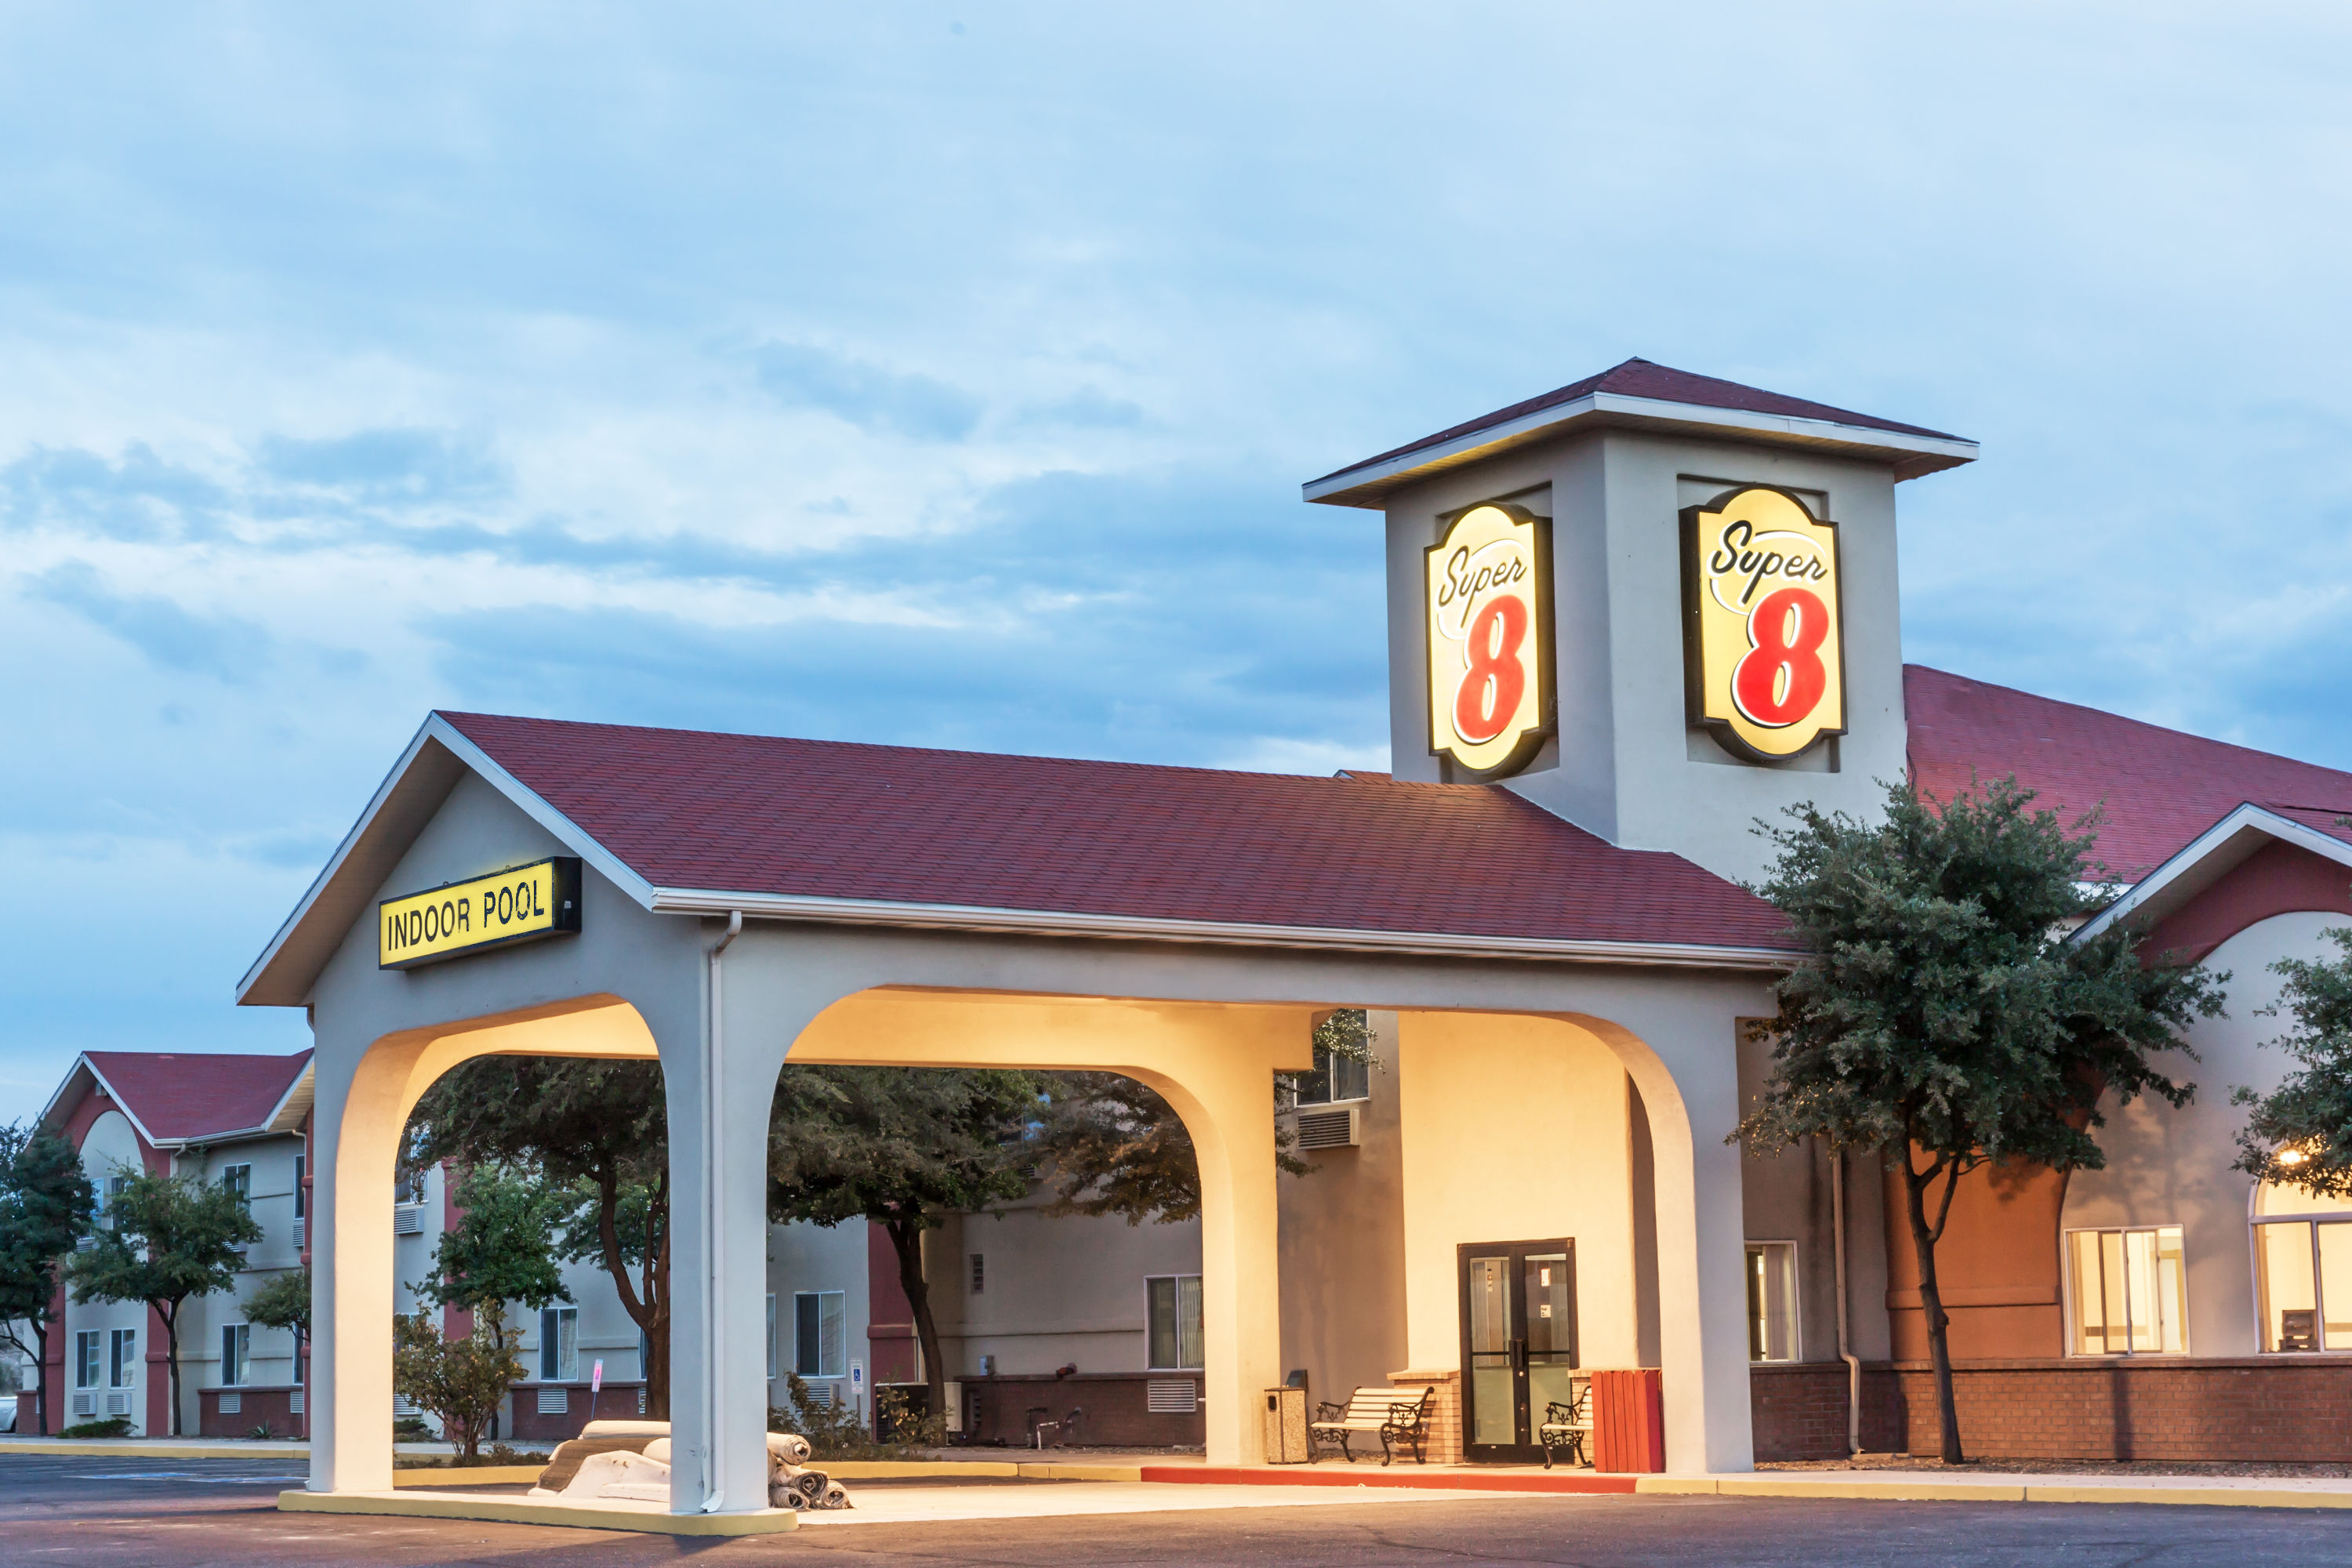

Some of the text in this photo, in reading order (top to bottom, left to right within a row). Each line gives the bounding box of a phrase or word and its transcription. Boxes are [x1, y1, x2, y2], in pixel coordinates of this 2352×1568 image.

[1438, 545, 1528, 629] Super
[1711, 519, 1828, 606] Super
[1453, 594, 1529, 745] 8
[1732, 587, 1830, 728] 8
[388, 880, 545, 952] INDOOR POOL
